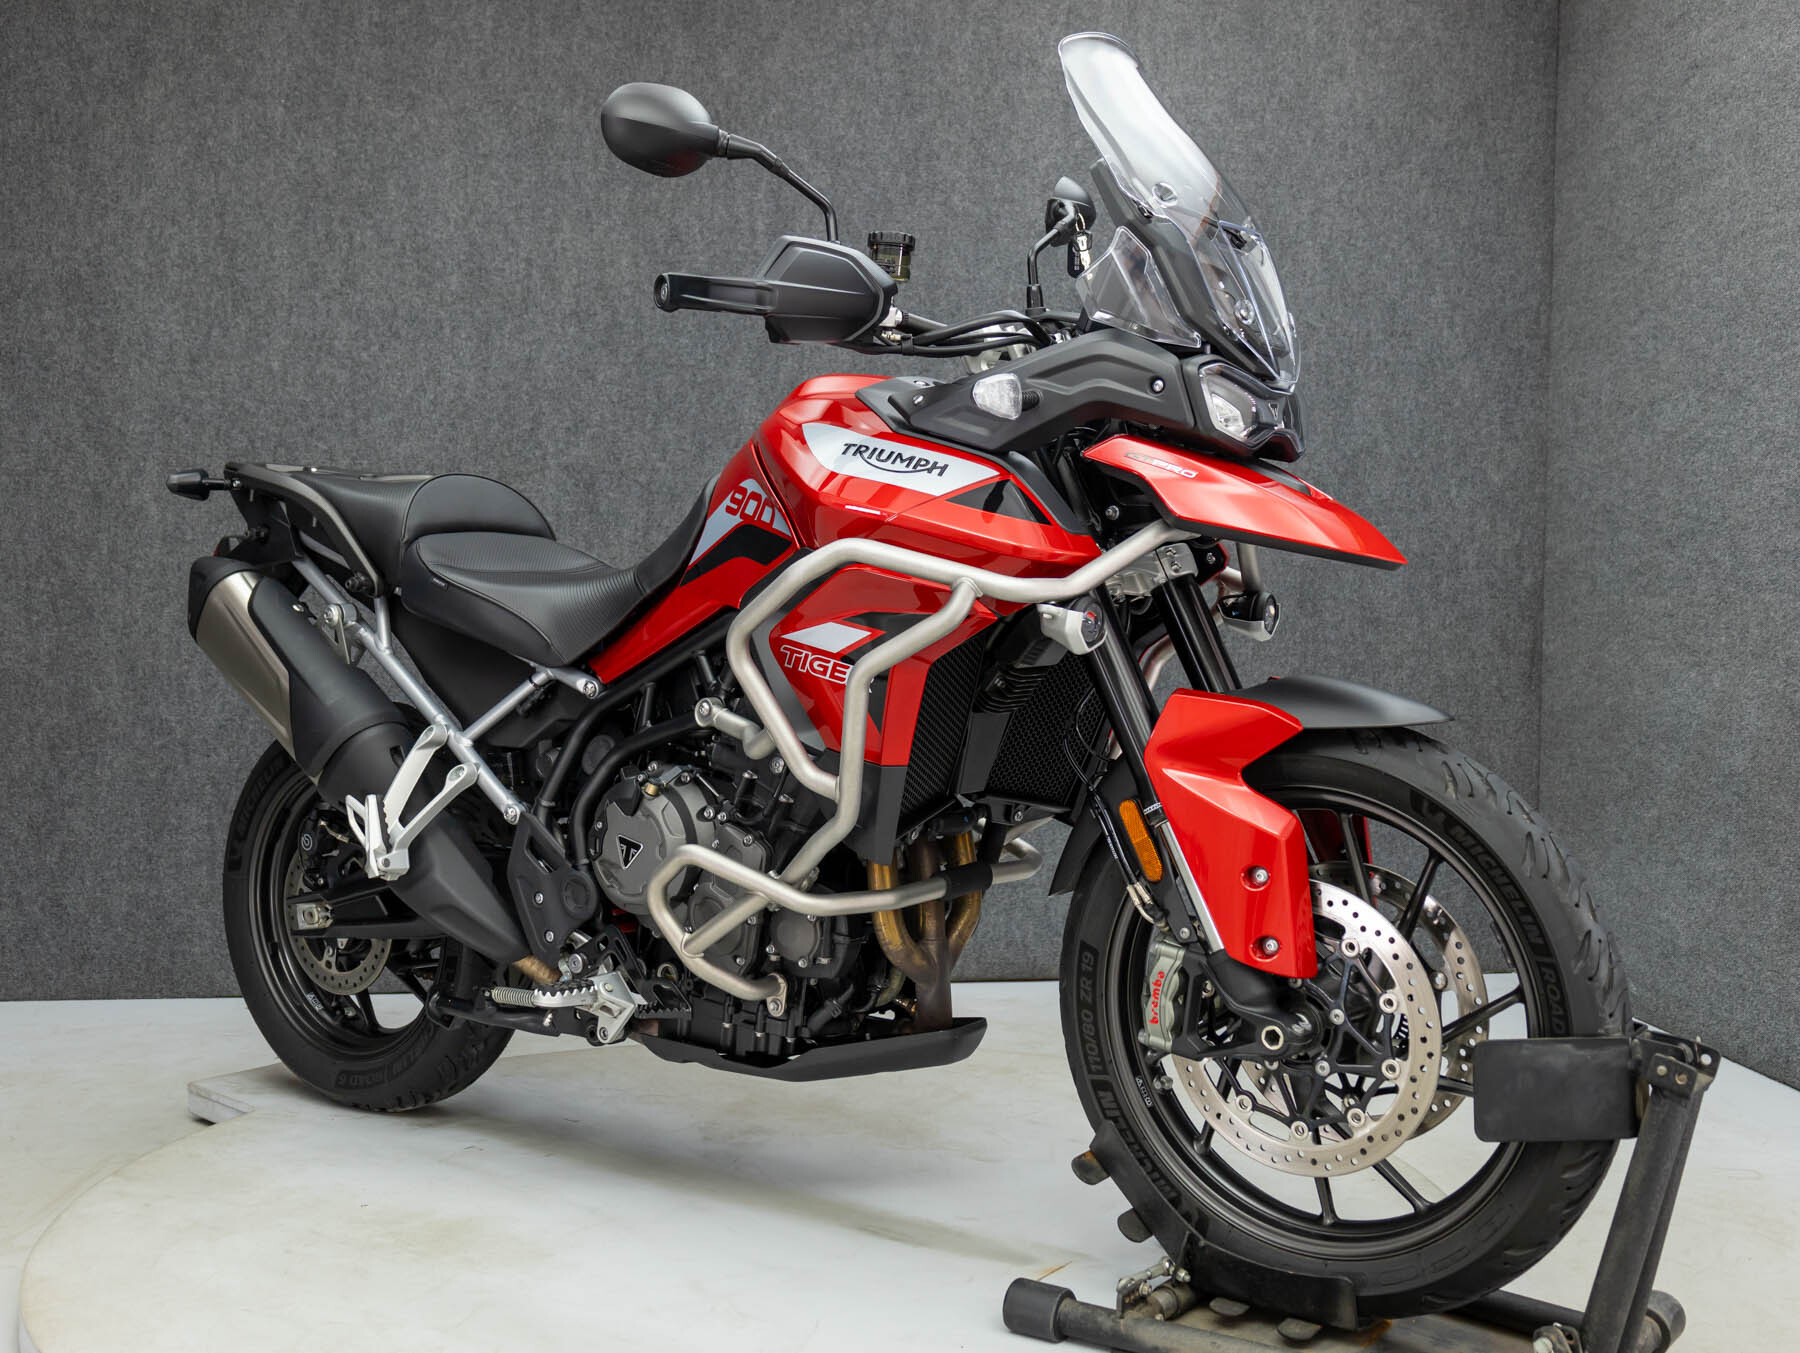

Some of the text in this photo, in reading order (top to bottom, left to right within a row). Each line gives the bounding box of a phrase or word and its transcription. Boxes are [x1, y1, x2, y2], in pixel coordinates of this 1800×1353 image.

[841, 443, 949, 477] TRIUMPH
[725, 485, 776, 529] 900
[780, 645, 872, 693] TIGE
[1450, 825, 1566, 1034] MICHELIN ROAD
[1081, 951, 1095, 972] 19
[1080, 977, 1094, 1004] ZR
[1149, 970, 1166, 1025] brembo
[1080, 1008, 1103, 1072] 110/80
